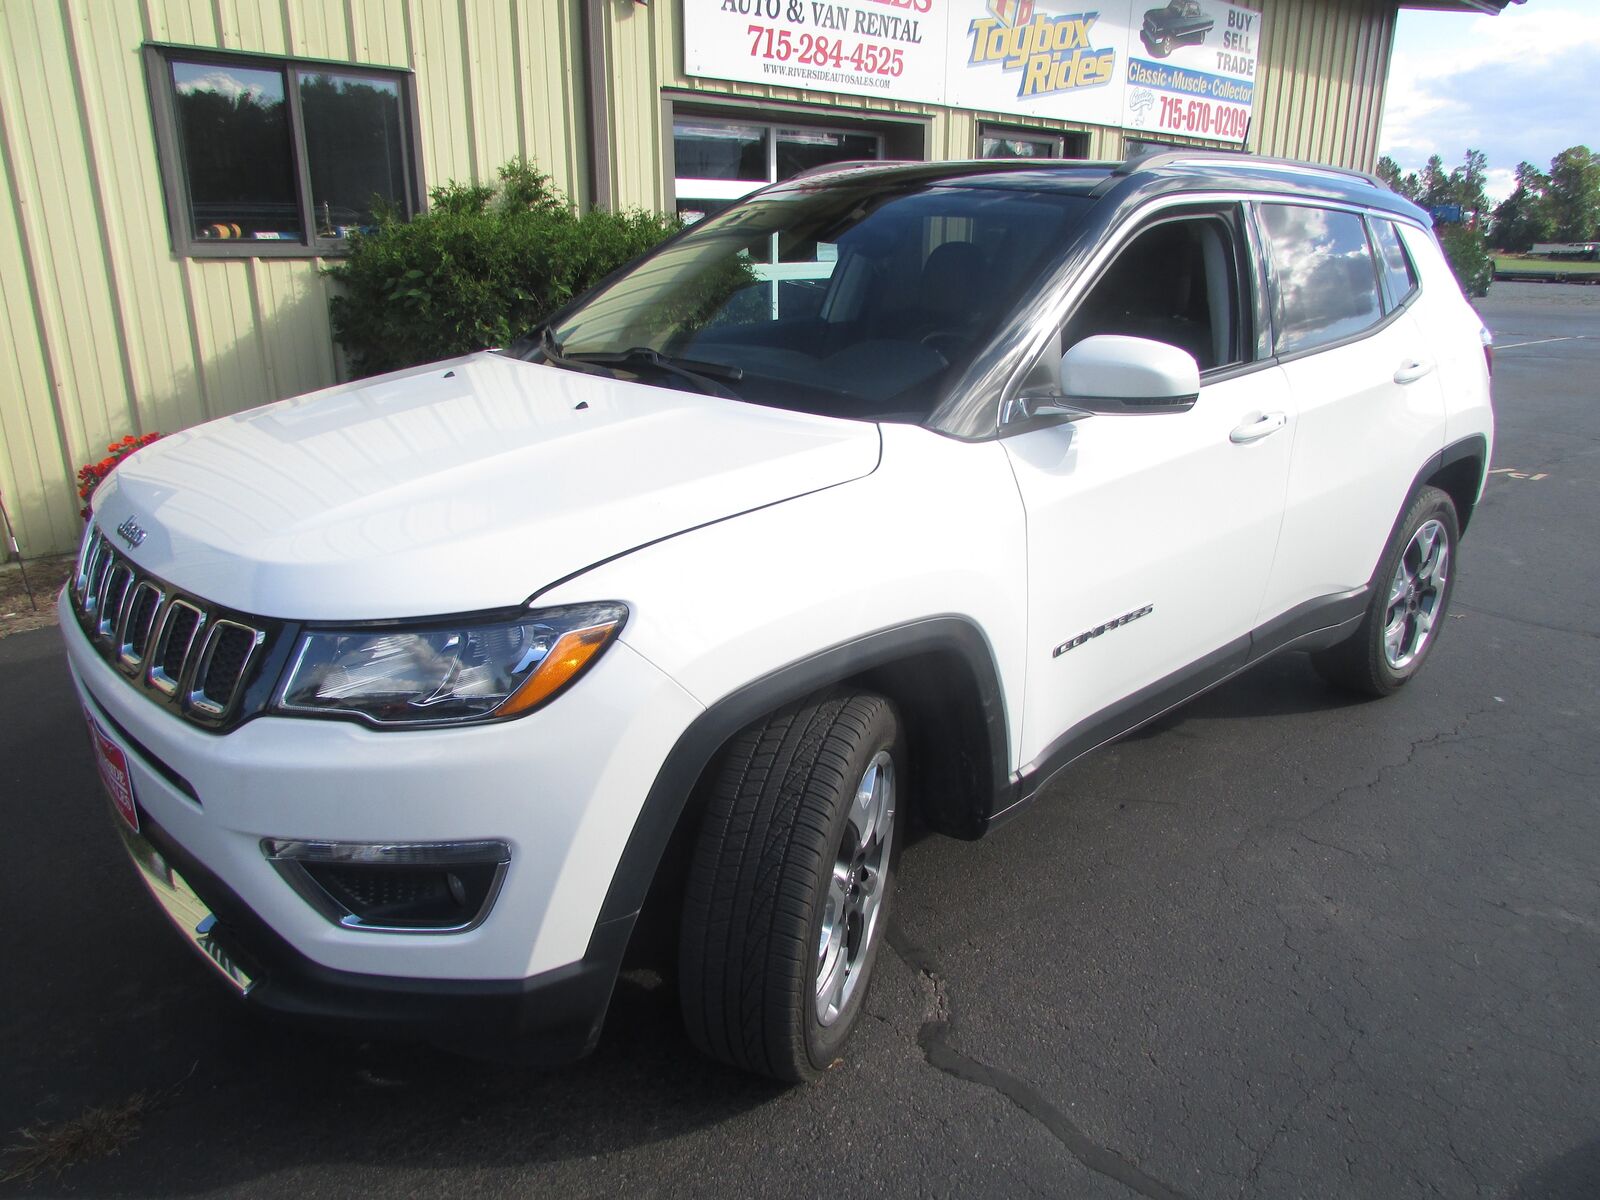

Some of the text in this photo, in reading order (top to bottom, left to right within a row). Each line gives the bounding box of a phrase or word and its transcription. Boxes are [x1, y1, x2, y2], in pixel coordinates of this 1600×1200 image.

[786, 0, 805, 24] &
[811, 1, 850, 31] VAN
[853, 9, 922, 44] RENTAL
[1228, 9, 1253, 32] BUY
[747, 24, 904, 77] 715-284-4525
[968, 12, 1099, 71] Toybox
[1223, 30, 1251, 54] SELL
[763, 63, 890, 89] WWW.RIVERSIDEAUTOSALES.COM
[1019, 48, 1115, 98] Rides
[1128, 62, 1253, 102] Classic Muscle Collector
[1217, 51, 1254, 76] TRADE
[1159, 96, 1247, 138] 715-670-0209
